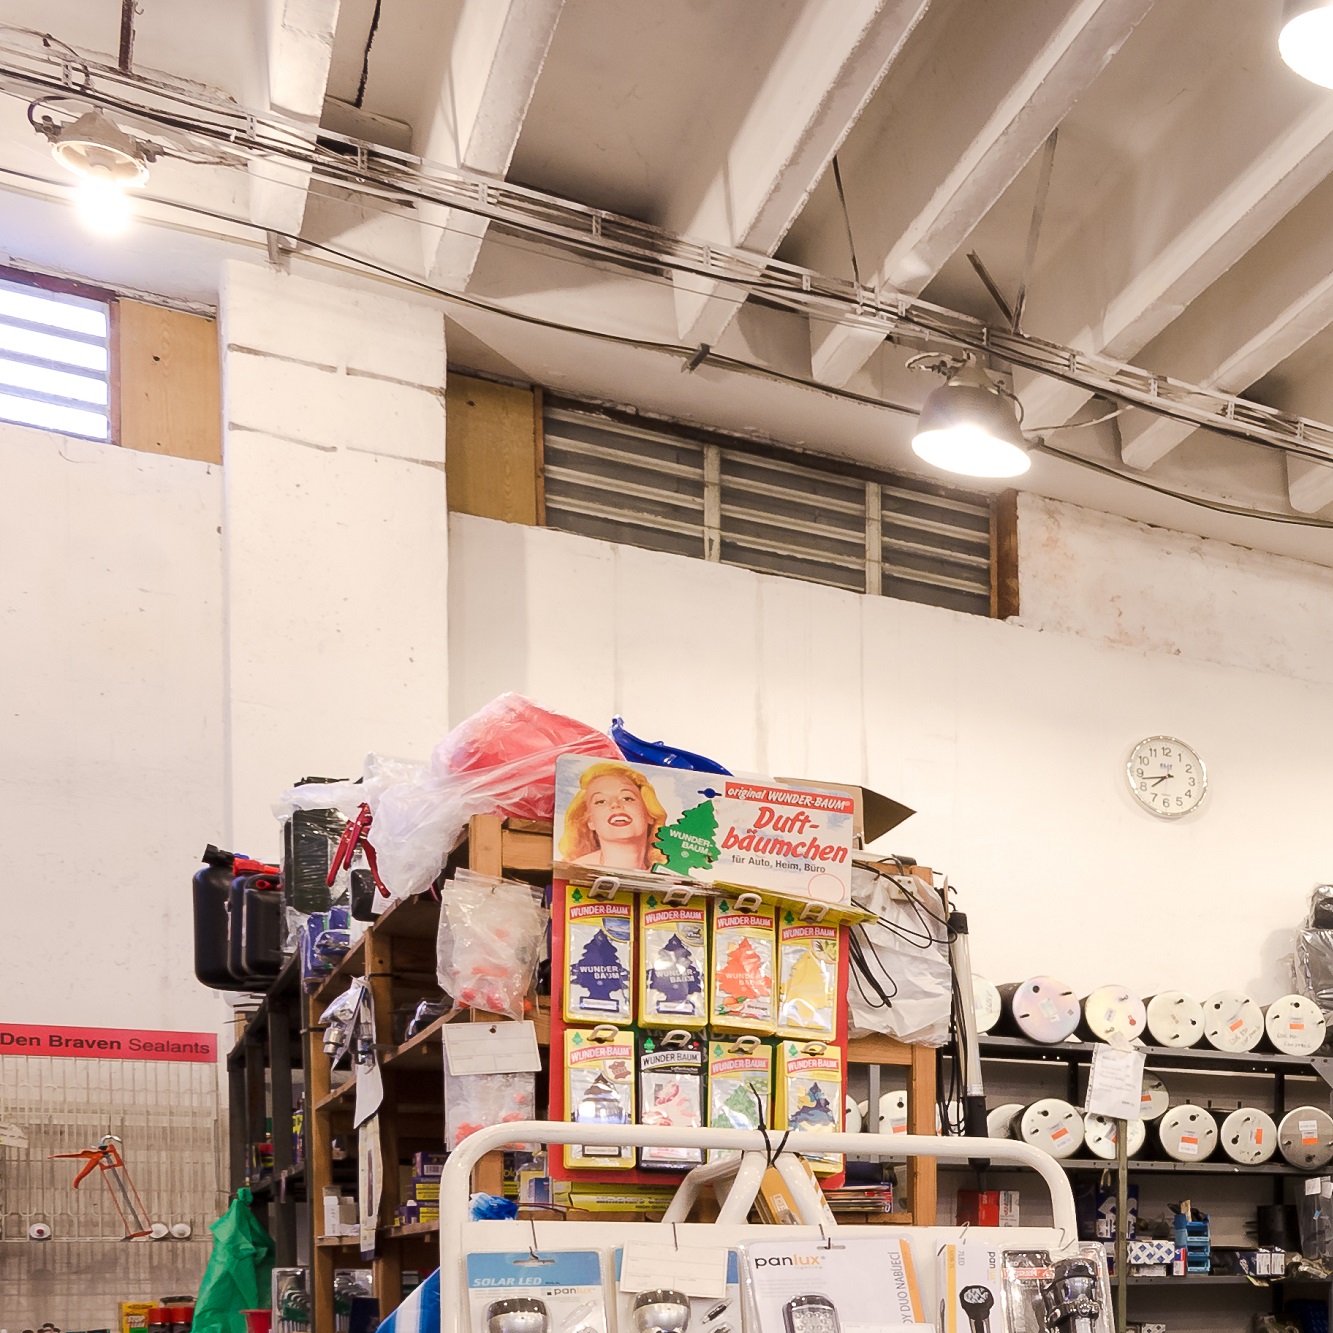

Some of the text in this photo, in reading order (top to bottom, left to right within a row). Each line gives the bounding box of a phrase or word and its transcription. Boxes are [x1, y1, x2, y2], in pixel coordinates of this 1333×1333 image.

[1149, 748, 1157, 758] 11
[1161, 747, 1172, 757] 12
[1138, 755, 1150, 766] 10
[1136, 768, 1144, 778] 9
[1185, 764, 1193, 774] 2
[1139, 782, 1148, 792] 8
[1188, 777, 1196, 787] 3
[726, 786, 766, 800] original
[1150, 793, 1158, 803] 7
[1184, 789, 1192, 799] 4
[1162, 798, 1170, 808] 6
[1175, 797, 1183, 807] 5
[754, 807, 820, 835] Duft-
[669, 829, 714, 848] WUNDER-
[681, 840, 710, 856] BAUM
[721, 829, 849, 865] bäumchen
[731, 855, 826, 874] für Auto, Heim, Büro
[1, 1032, 211, 1056] Den Braven Sealants
[472, 1276, 542, 1287] SOLAR LED
[887, 1251, 909, 1312] DUO NABÍJECÍ
